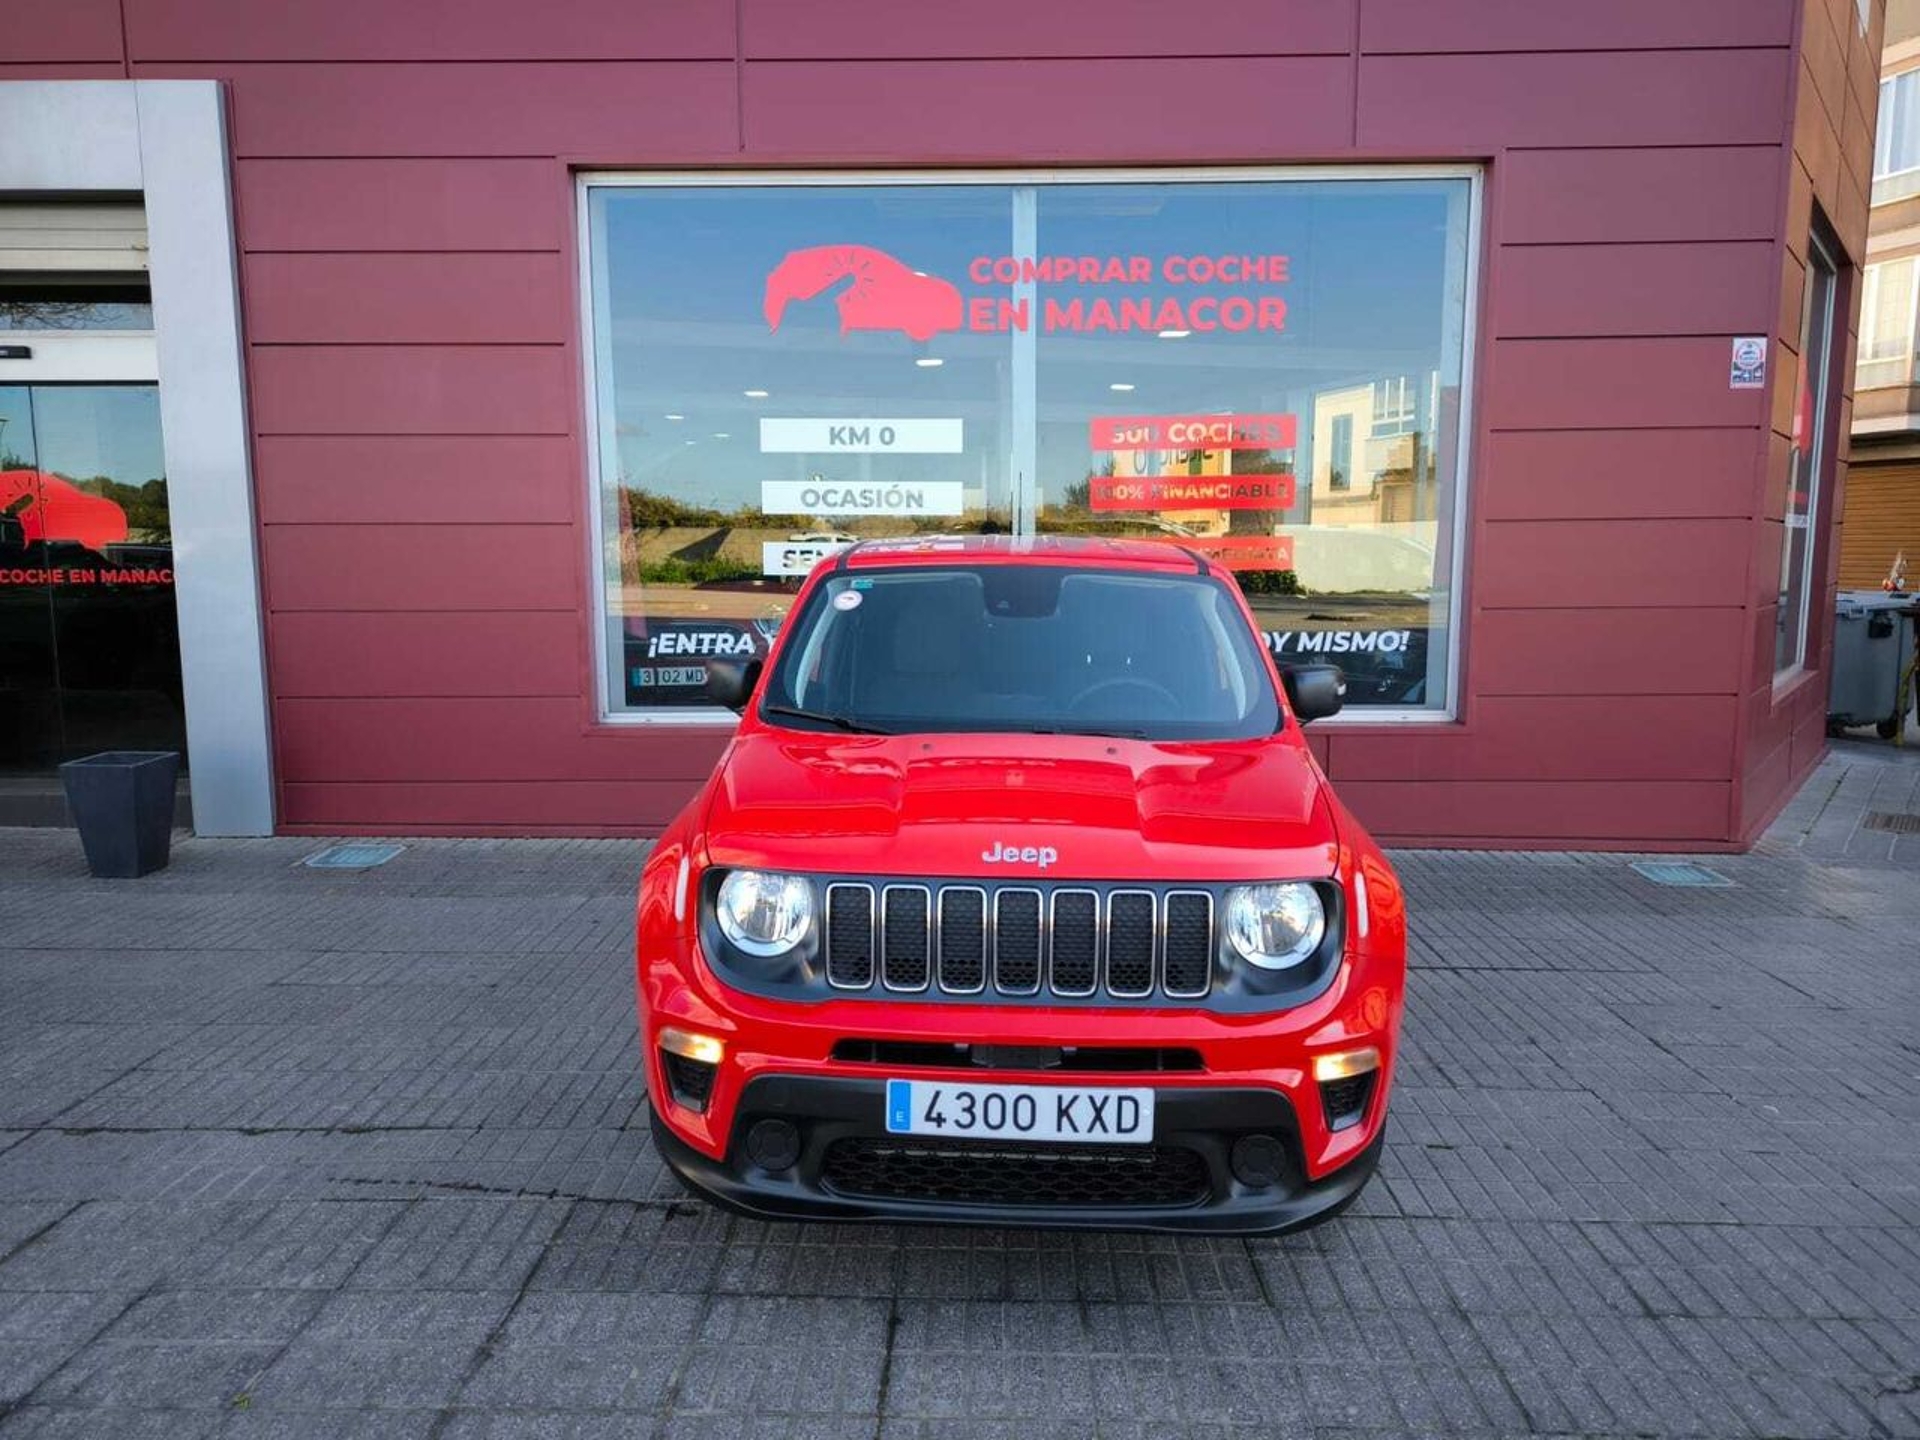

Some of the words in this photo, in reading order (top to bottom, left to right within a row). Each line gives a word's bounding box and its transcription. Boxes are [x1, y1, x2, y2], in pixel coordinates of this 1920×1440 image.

[968, 256, 1152, 284] COMPRAR
[1162, 255, 1290, 283] COCHE
[968, 298, 1029, 333] EN
[1044, 297, 1287, 333] MANACOR
[829, 426, 870, 446] KM
[879, 426, 896, 446] 0
[1168, 422, 1282, 444] COCHES
[800, 484, 924, 509] OCASIÓN
[1151, 483, 1288, 500] FINANCIABLE
[0, 569, 65, 584] COCHE
[69, 569, 96, 584] EN
[648, 632, 757, 658] ¡ENTRA
[1296, 630, 1411, 653] MISMO!
[981, 841, 1058, 869] Jeep
[924, 1089, 1037, 1132] 4300
[1056, 1094, 1140, 1134] KXD
